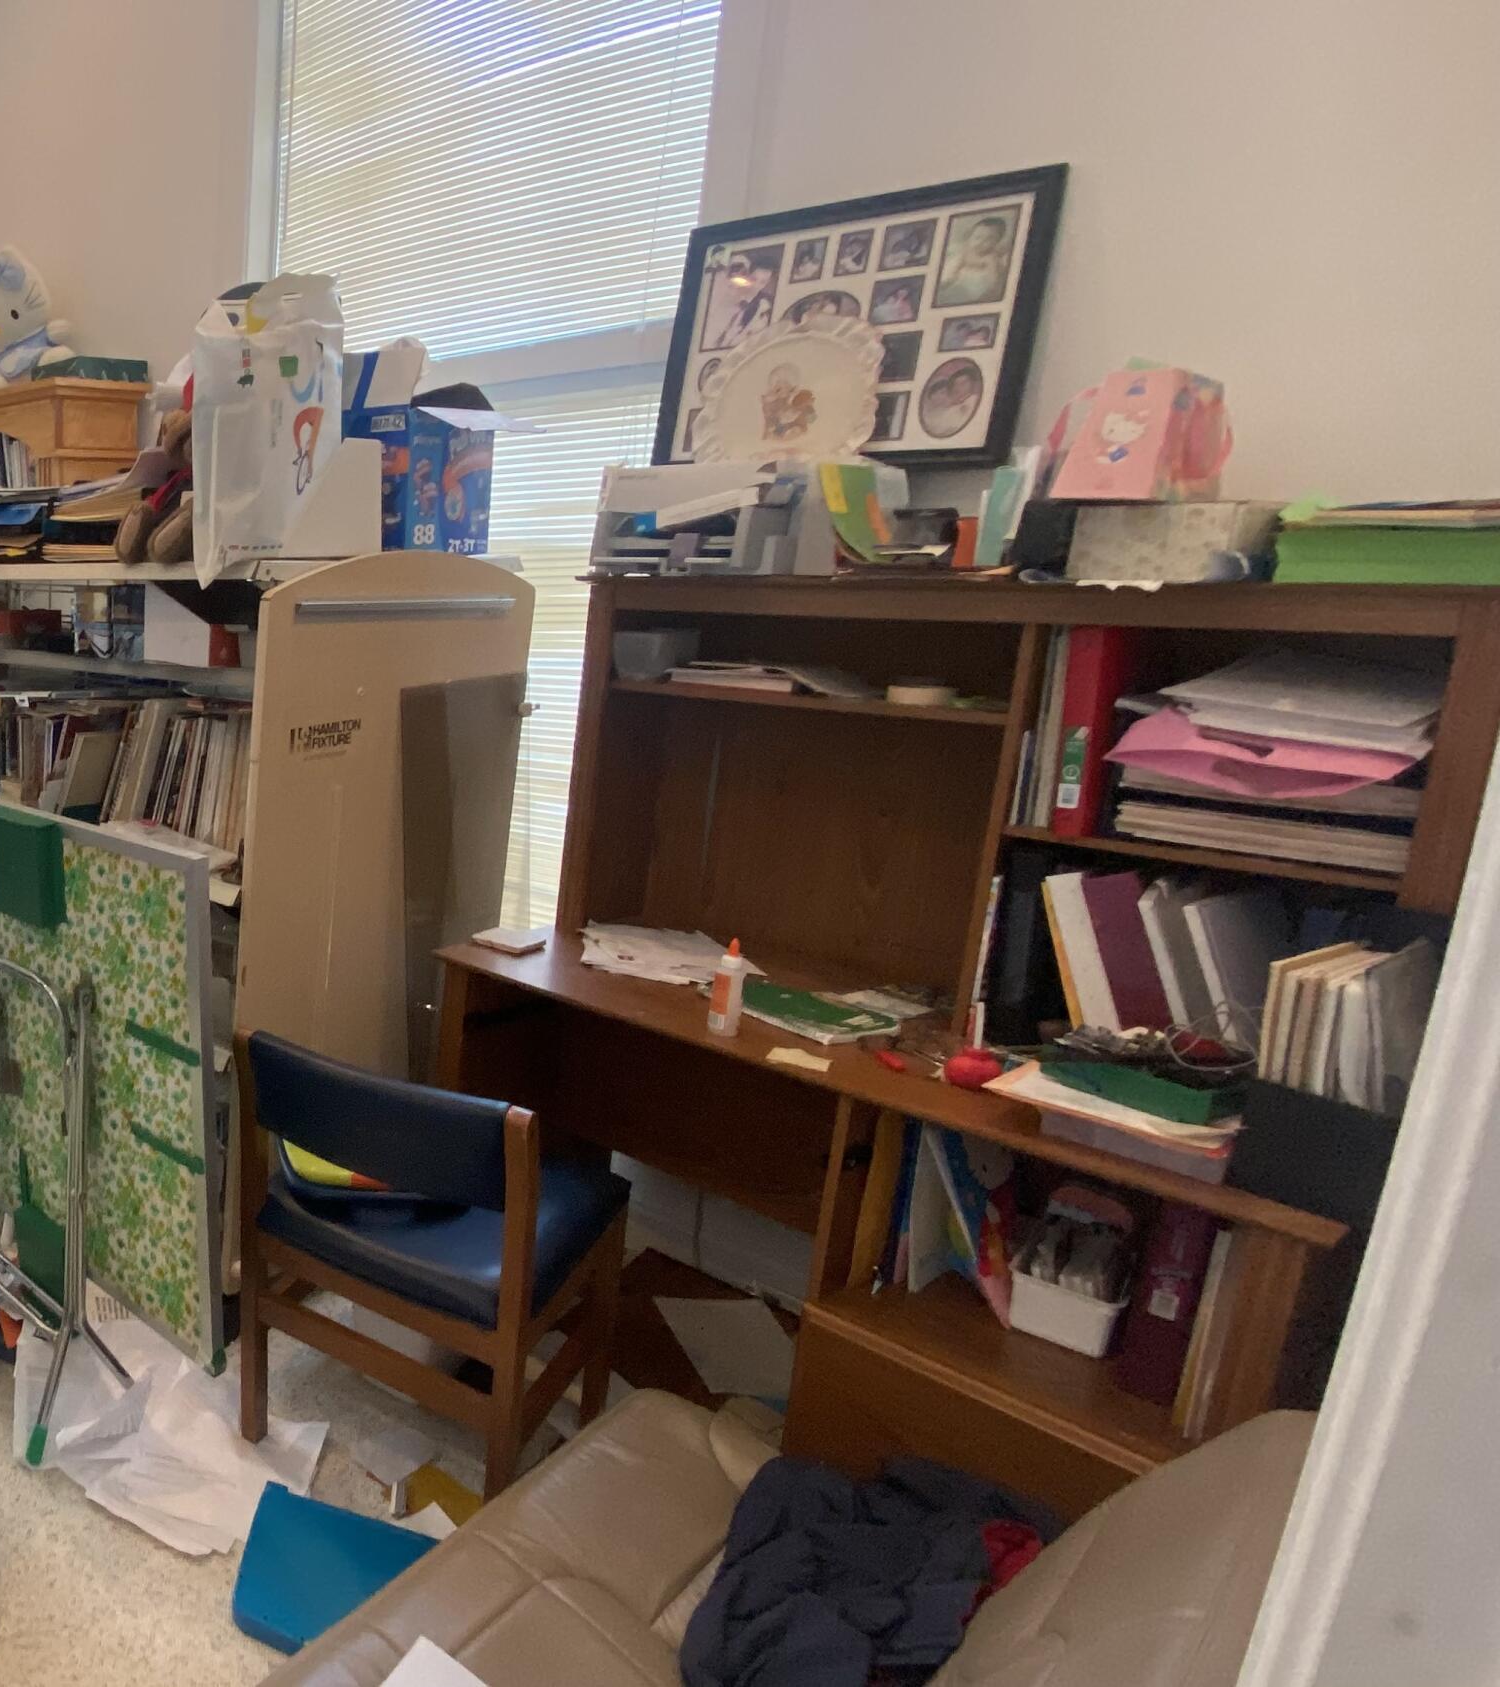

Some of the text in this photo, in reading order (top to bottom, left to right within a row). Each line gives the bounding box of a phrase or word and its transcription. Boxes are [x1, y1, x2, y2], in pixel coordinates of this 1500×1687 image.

[412, 523, 436, 546] 88
[312, 718, 363, 737] HAMILTON
[311, 731, 352, 749] FIXTURE
